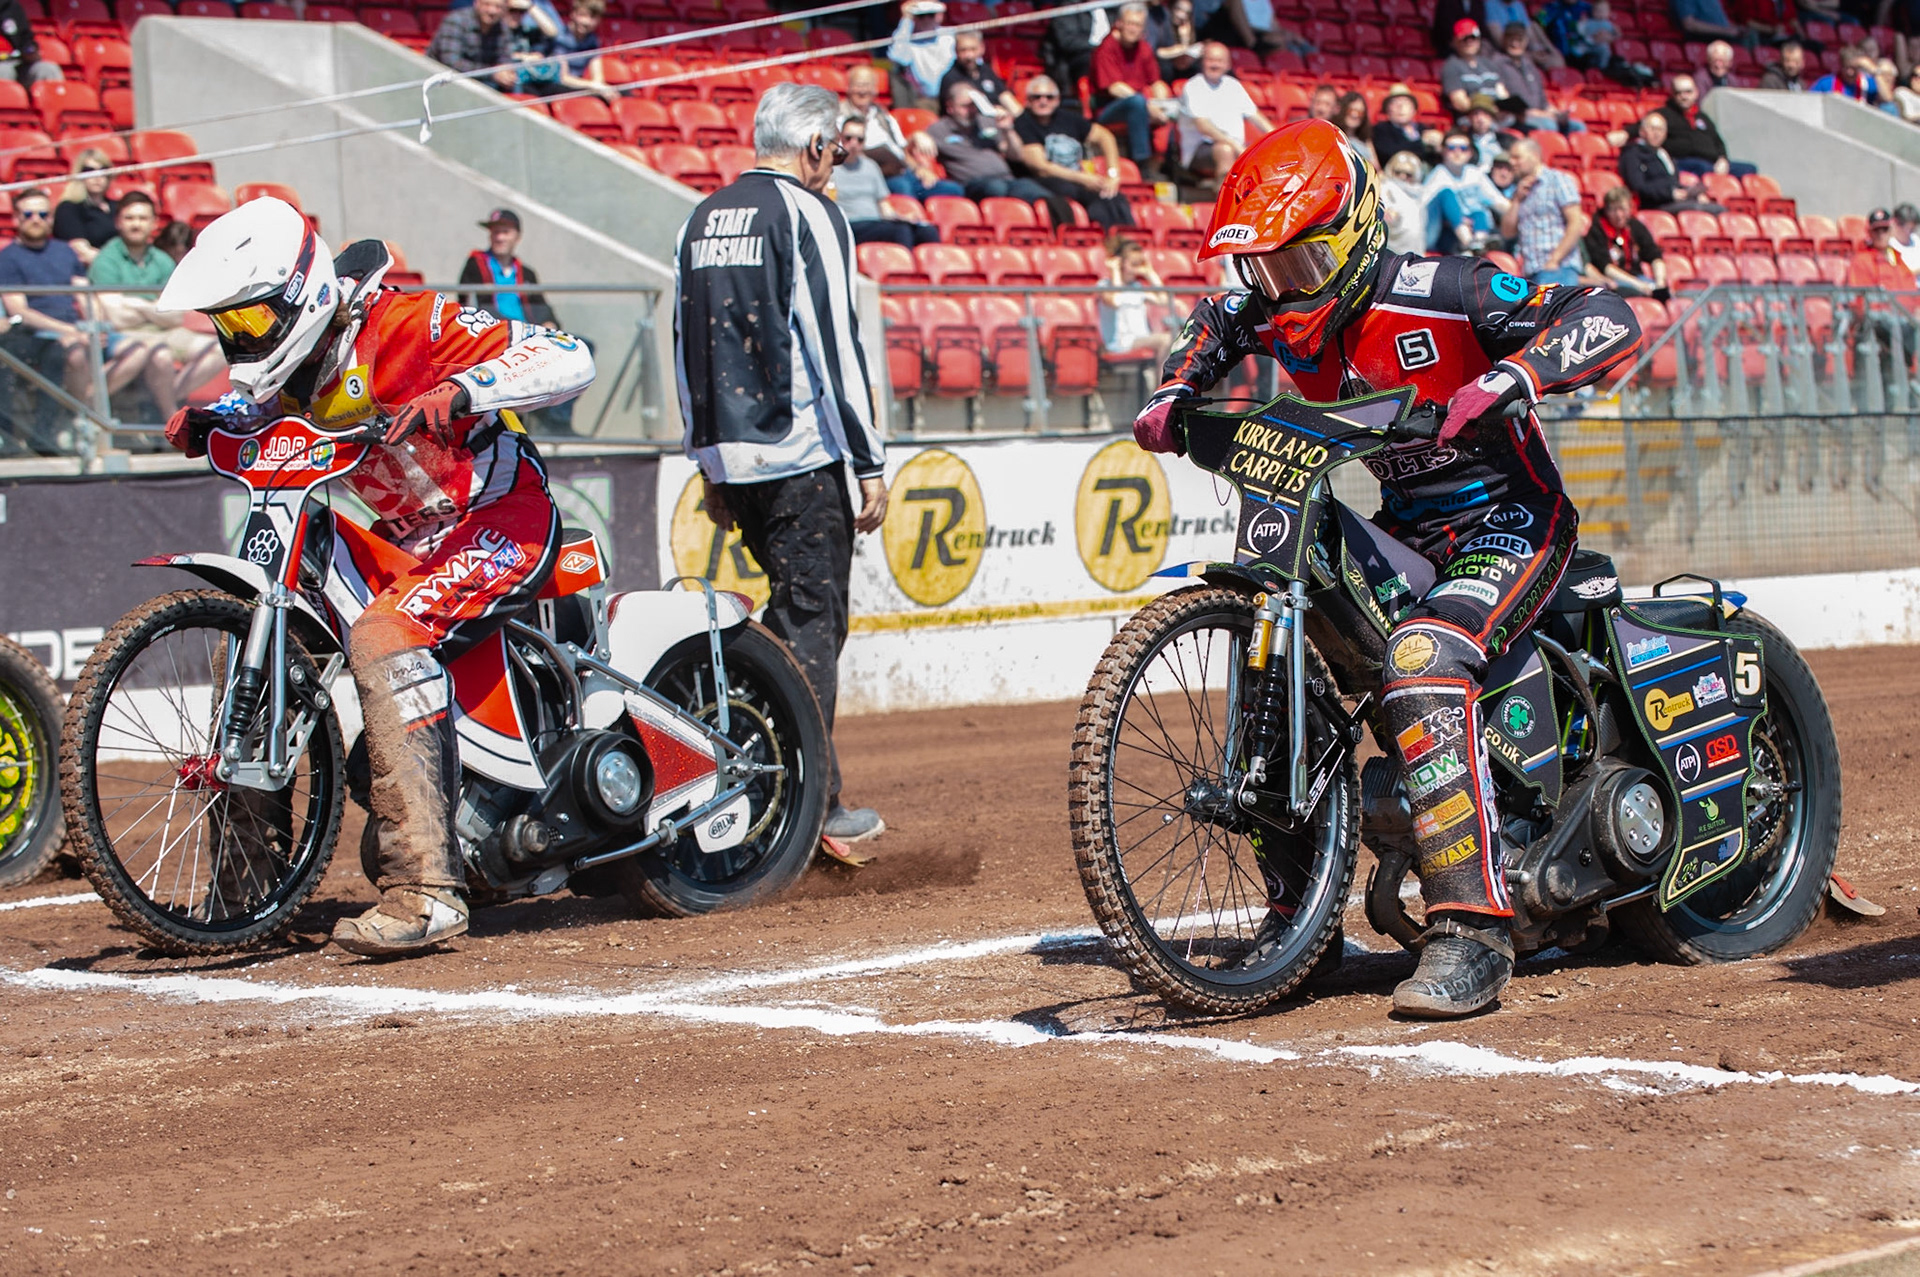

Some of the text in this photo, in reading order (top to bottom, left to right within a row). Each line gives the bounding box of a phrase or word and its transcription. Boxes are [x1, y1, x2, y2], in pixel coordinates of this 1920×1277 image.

[704, 207, 759, 237] START
[1213, 228, 1249, 243] SHOEI
[690, 236, 764, 271] MARSHALL
[1402, 336, 1429, 364] 5
[349, 378, 361, 395] 3
[1232, 419, 1329, 469] KIRKLAND
[901, 486, 1056, 570] Rentruck
[1093, 476, 1236, 556] Rentruck
[1252, 522, 1283, 539] ATPI
[1468, 534, 1527, 556] SHOEI
[404, 526, 507, 617] RYMAC
[1445, 552, 1518, 576] GRAHAM
[1451, 565, 1504, 582] LLOYD
[1451, 580, 1496, 601] SPRINT
[1512, 575, 1550, 625] SPORTS
[1734, 651, 1762, 696] 5
[1649, 696, 1691, 721] Rentruck
[1484, 726, 1521, 765] co.uk
[1680, 754, 1697, 771] ATPI
[1435, 798, 1470, 821] NEB
[1706, 818, 1727, 830] SUTTON
